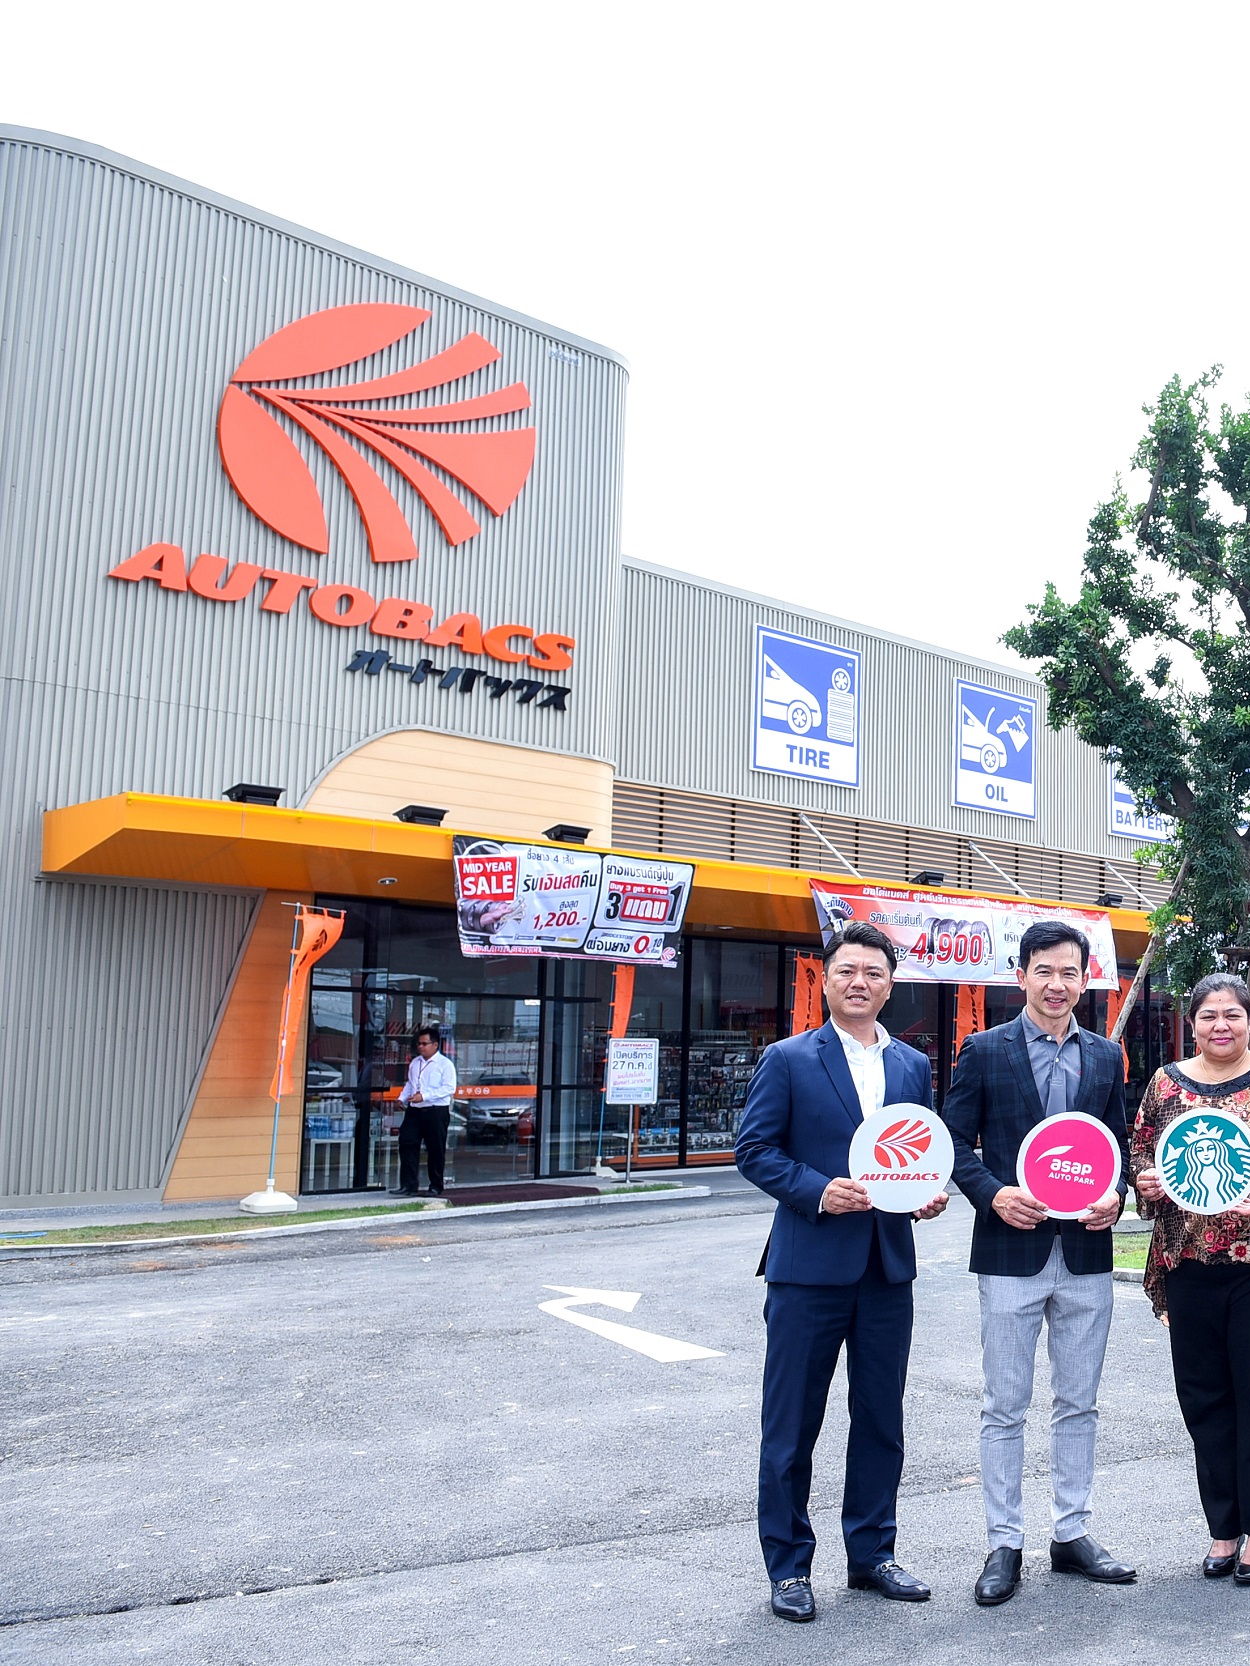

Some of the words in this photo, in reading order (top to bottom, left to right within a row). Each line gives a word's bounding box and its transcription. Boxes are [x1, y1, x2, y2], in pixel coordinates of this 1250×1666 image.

[107, 541, 576, 671] AUTOBACS
[344, 648, 573, 711] オートバックス
[786, 744, 830, 769] TIRE
[984, 784, 1009, 803] OIL
[1116, 809, 1171, 832] BATTERY
[463, 861, 484, 873] MID
[485, 861, 513, 872] YEAR
[553, 854, 560, 863] 4
[463, 874, 514, 896] SALE
[522, 870, 598, 892] รับเงินสดคืน
[609, 882, 624, 892] Buy
[632, 885, 645, 893] get
[652, 887, 668, 895] Free
[605, 892, 622, 919] 3
[623, 898, 667, 920] แถม
[668, 885, 683, 921] 1
[533, 911, 587, 930] 1,200.-
[652, 938, 662, 947] 10
[613, 1050, 653, 1060] เปิดบริการ
[612, 1060, 625, 1070] 27
[627, 1061, 647, 1070] ก.ค.
[1050, 1158, 1092, 1176] asap
[859, 1172, 940, 1181] AUTOBACS
[1048, 1172, 1071, 1181] AUTO
[1073, 1176, 1095, 1186] PARK
